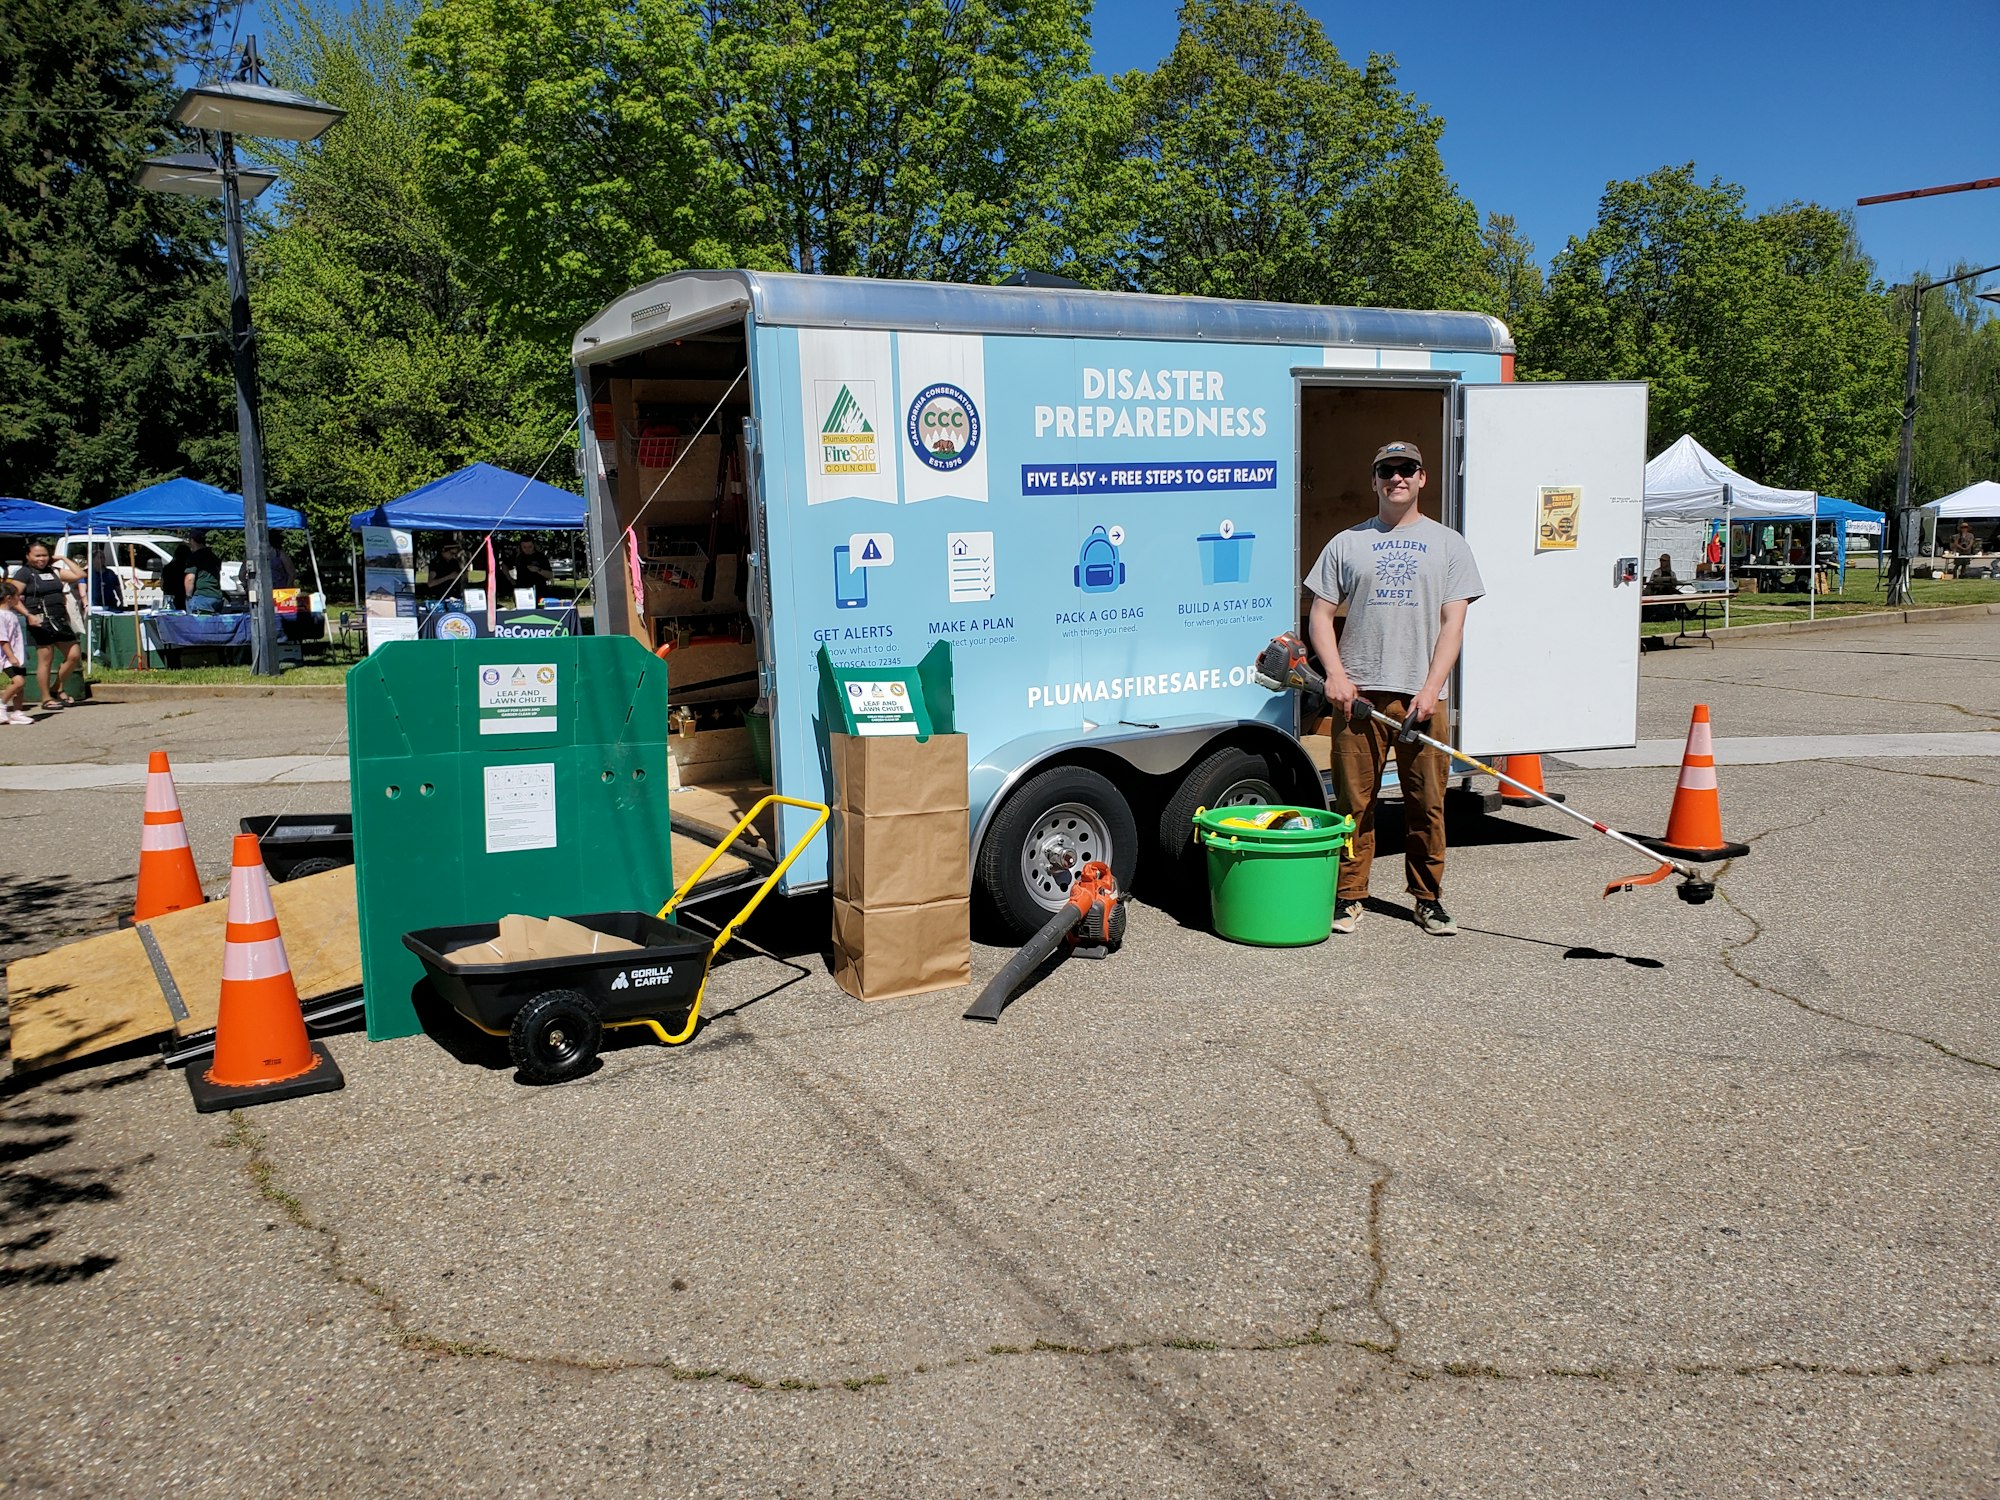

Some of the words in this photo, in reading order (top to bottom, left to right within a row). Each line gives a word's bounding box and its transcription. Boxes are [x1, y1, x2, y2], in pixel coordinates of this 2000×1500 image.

[1083, 367, 1224, 400] DISASTER
[910, 397, 926, 446] CALIFORNIA
[925, 387, 975, 417] CONSERVATION
[969, 418, 978, 447] CORPS
[924, 411, 963, 428] CCC
[1034, 405, 1267, 438] PREPAREDNESS
[823, 435, 849, 443] Plumas
[849, 435, 874, 444] County
[825, 464, 875, 473] COUNCIL
[928, 457, 945, 469] EST.
[945, 457, 963, 469] 1976
[1027, 471, 1058, 488] FIVE
[1061, 470, 1097, 487] EASY
[1111, 470, 1143, 486] FREE
[1145, 469, 1183, 485] STEPS
[1185, 468, 1204, 484] TO
[1206, 468, 1232, 483] GET
[1233, 467, 1275, 483] READY
[1371, 540, 1427, 554] WALDEN
[1375, 589, 1413, 599] WEST
[1178, 602, 1210, 614] BUILD
[1213, 601, 1221, 612] A
[1223, 599, 1249, 611] STAY
[1251, 597, 1273, 609] BOX
[1367, 598, 1396, 607] Summer
[1397, 599, 1419, 608] Camp
[1055, 611, 1086, 624] PACK
[1089, 610, 1098, 622] A
[1100, 608, 1118, 621] GO
[1121, 607, 1144, 619] BAG
[1184, 619, 1195, 627] for
[1195, 618, 1215, 627] when
[1215, 617, 1228, 626] you
[1229, 615, 1246, 624] can't
[1246, 614, 1265, 622] leave.
[813, 628, 840, 641] GET
[844, 624, 893, 640] ALERTS
[928, 620, 966, 634] MAKE
[970, 619, 979, 631] A
[983, 617, 1014, 631] PLAN
[1062, 628, 1079, 638] with
[1080, 627, 1102, 637] things
[1103, 627, 1117, 636] you
[1118, 624, 1138, 633] need.
[969, 638, 987, 648] your
[989, 634, 1018, 645] people.
[849, 644, 873, 655] what
[873, 645, 884, 653] to
[885, 642, 900, 652] do.
[868, 659, 877, 667] to
[878, 657, 902, 666] 72345
[1027, 664, 1258, 709] PLUMASFIRESAFE.OR
[497, 690, 519, 698] LEAF
[631, 966, 673, 978] GORILLA
[634, 975, 670, 987] CARTS
